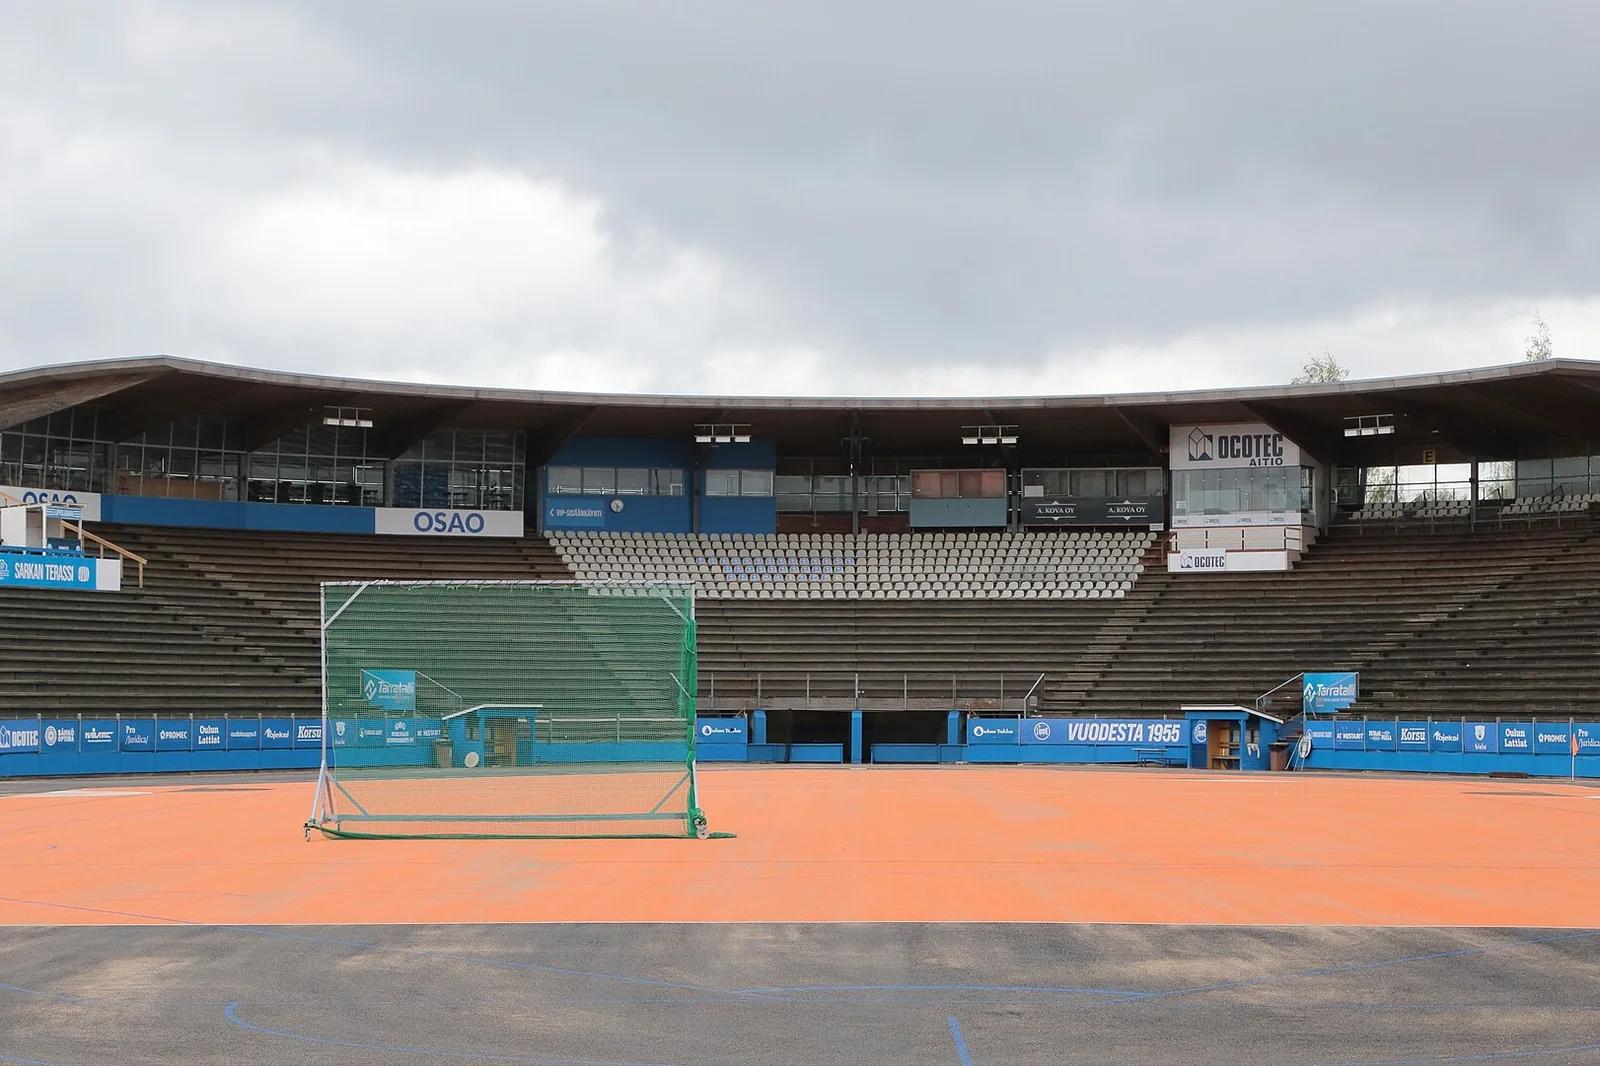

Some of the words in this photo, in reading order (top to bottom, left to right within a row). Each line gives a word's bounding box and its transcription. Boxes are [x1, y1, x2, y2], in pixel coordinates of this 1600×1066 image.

[1218, 433, 1283, 459] OCOTEC
[1249, 457, 1283, 467] AITIO
[413, 511, 485, 533] OSAO
[1194, 556, 1225, 568] OCOTEC
[14, 562, 43, 580] SARKAN
[45, 564, 74, 582] TERASSI
[1317, 684, 1356, 697] Tarratalli
[125, 725, 136, 734] Pro
[165, 731, 187, 739] PROMEC
[199, 725, 219, 734] Oulun
[297, 725, 322, 738] Korsu
[1068, 723, 1143, 742] VUODESTA
[1147, 724, 1180, 742] 1955
[1401, 728, 1426, 741] Korsu
[1505, 728, 1525, 737] Oulun
[1578, 728, 1589, 737] Pro
[11, 730, 38, 747] OCOTEC
[198, 735, 220, 744] Lattiat
[1504, 738, 1528, 747] Lattiat
[1544, 734, 1567, 743] PROMEC
